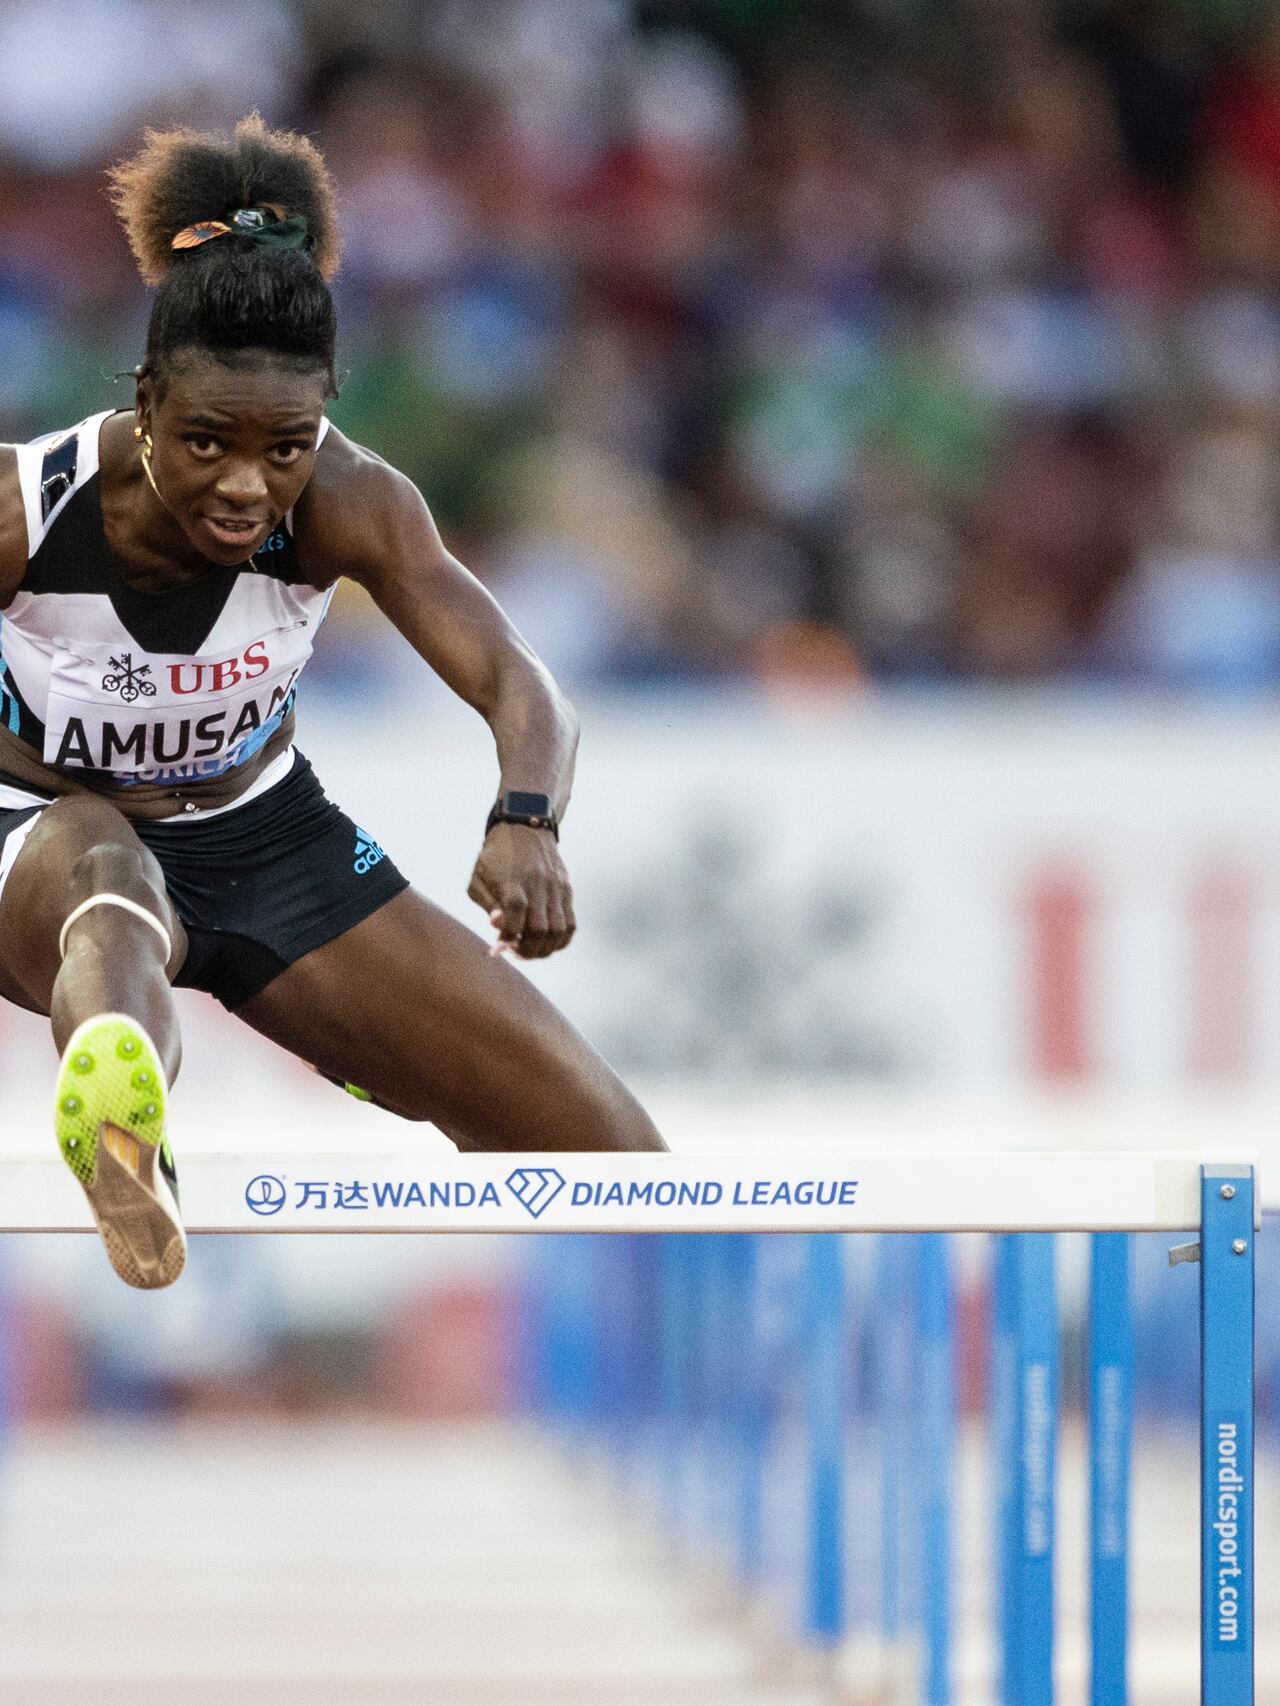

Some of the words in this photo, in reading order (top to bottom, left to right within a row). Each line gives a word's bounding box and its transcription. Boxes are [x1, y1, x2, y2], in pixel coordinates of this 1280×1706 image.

[167, 640, 270, 695] UBS
[294, 1180, 369, 1210] 万达
[372, 1181, 503, 1208] WANDA
[570, 1181, 724, 1207] DIAMOND
[731, 1180, 860, 1206] LEAGUE
[1213, 1423, 1244, 1643] nordicsport.com
